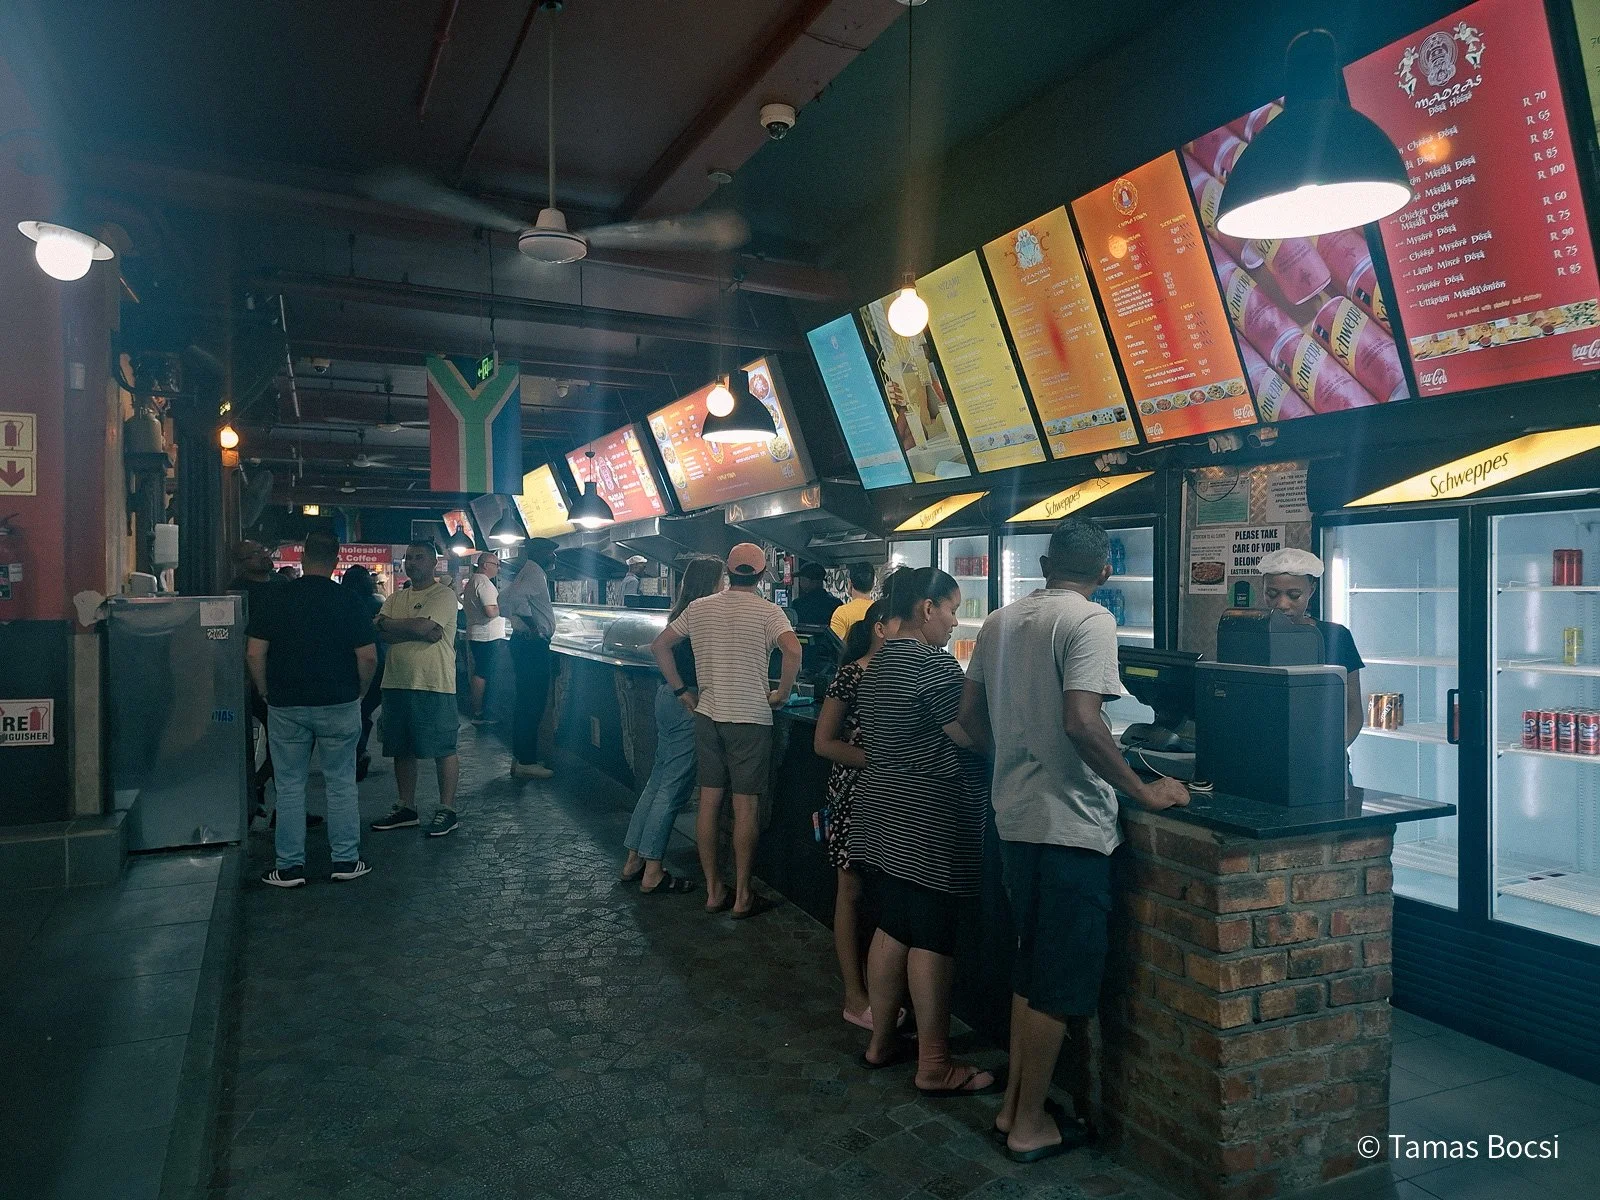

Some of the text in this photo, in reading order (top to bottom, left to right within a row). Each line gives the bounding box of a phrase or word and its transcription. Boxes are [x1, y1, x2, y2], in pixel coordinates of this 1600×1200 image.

[1415, 74, 1482, 109] MADRAS
[1523, 90, 1546, 107] R 70
[1526, 109, 1550, 125] R 65
[1530, 127, 1554, 144] R 85
[1534, 146, 1558, 162] R 85
[1537, 163, 1565, 180] R 100
[1543, 190, 1567, 206] R 60
[1546, 208, 1571, 224] R 75
[1550, 226, 1574, 242] R 90
[1554, 244, 1578, 259] R 75
[1557, 262, 1582, 276] R 85
[1430, 452, 1510, 498] Schweppes
[1045, 489, 1081, 518] Schweppes
[1235, 529, 1278, 540] PLEASE TAKE
[1232, 543, 1250, 553] CARE
[1251, 543, 1261, 552] OF
[1261, 542, 1281, 552] YOUR
[346, 554, 377, 562] Coffee
